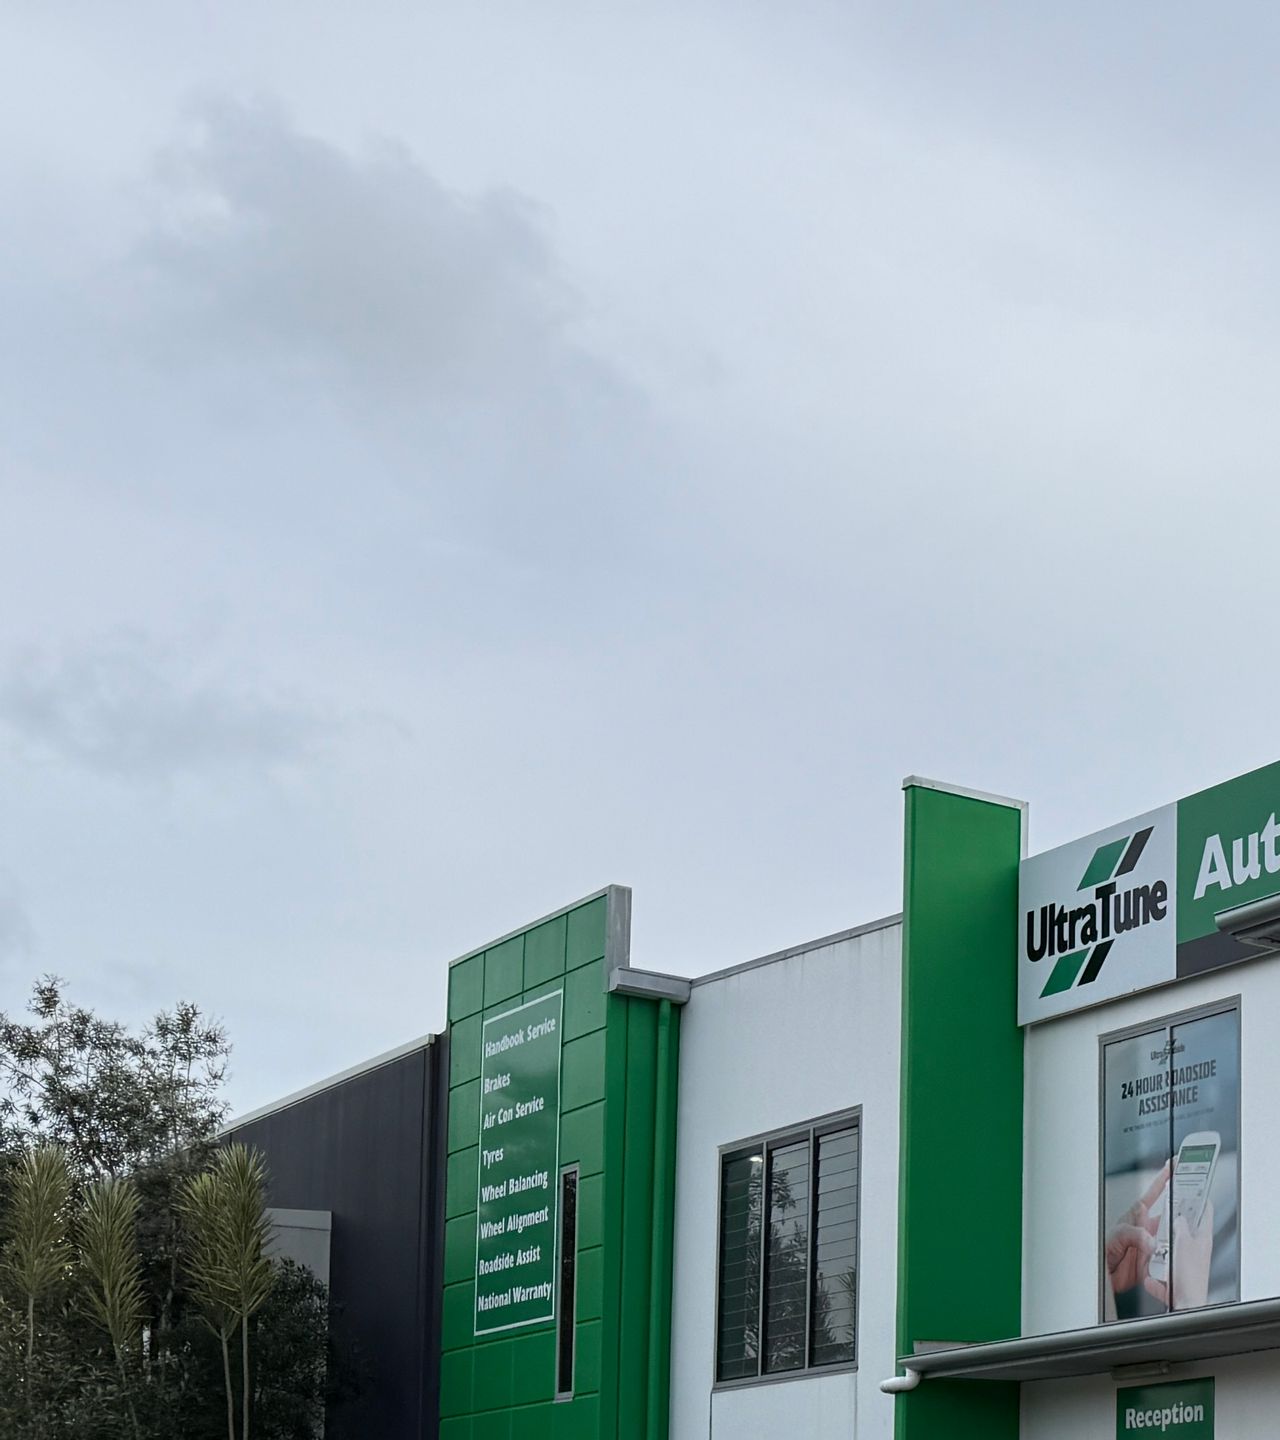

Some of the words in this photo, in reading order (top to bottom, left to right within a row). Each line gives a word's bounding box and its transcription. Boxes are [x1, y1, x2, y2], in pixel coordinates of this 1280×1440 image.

[486, 1029, 524, 1058] Handbook
[528, 1018, 556, 1041] Service
[484, 1073, 510, 1094] Brakes
[1121, 1081, 1134, 1100] 24
[1136, 1074, 1162, 1096] HOUR
[484, 1112, 496, 1130] Air
[498, 1108, 513, 1124] Con
[516, 1096, 544, 1118] Service
[482, 1148, 504, 1169] Tyres
[482, 1180, 506, 1202] Wheel
[508, 1170, 548, 1194] Balancing
[480, 1218, 504, 1239] Wheel
[507, 1206, 548, 1234] Alignment
[479, 1253, 514, 1276] Roadside
[516, 1245, 540, 1266] Assist
[478, 1288, 512, 1312] National
[512, 1282, 552, 1303] Warranty
[1126, 1401, 1204, 1432] Reception
